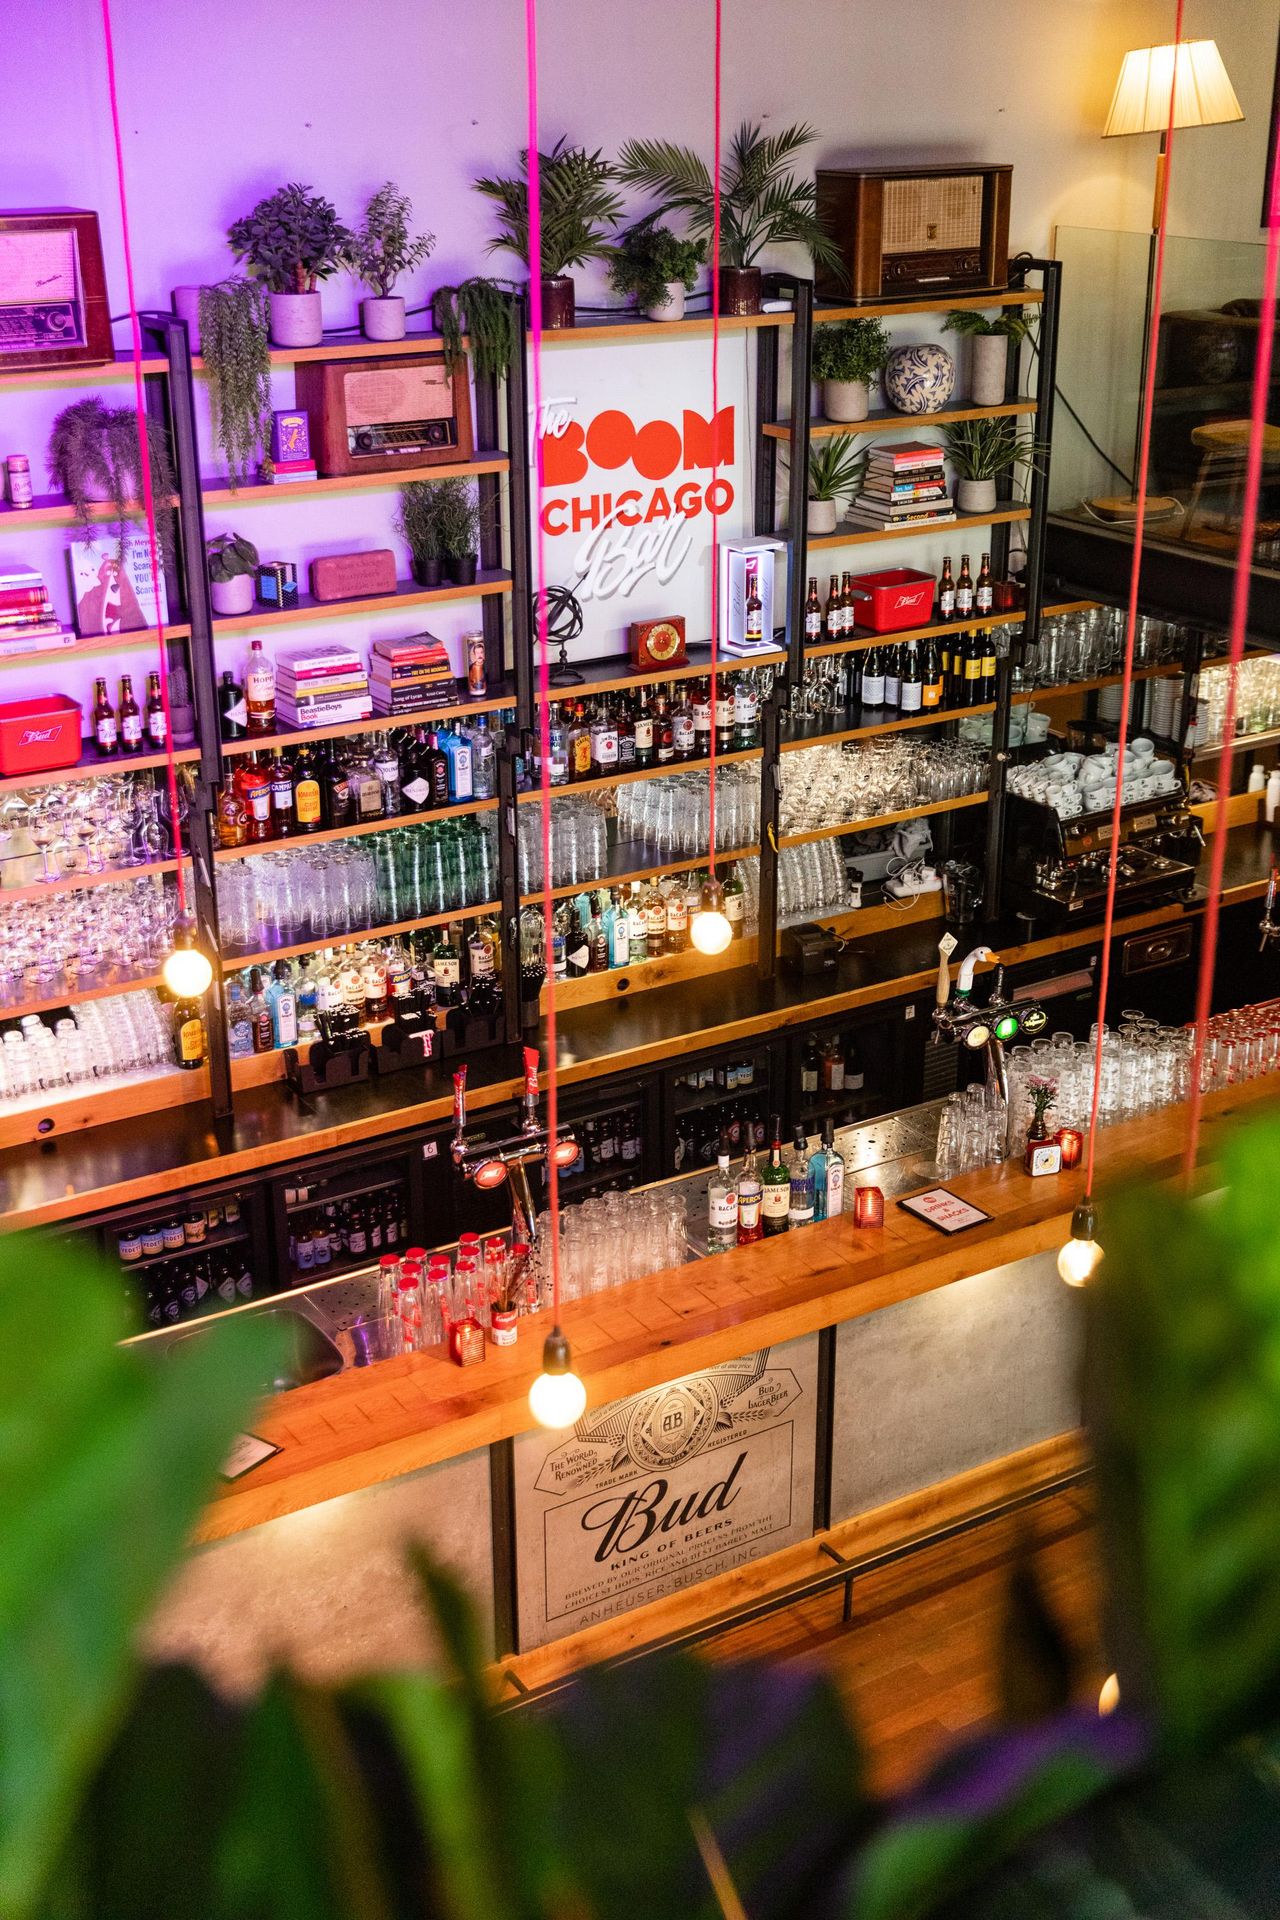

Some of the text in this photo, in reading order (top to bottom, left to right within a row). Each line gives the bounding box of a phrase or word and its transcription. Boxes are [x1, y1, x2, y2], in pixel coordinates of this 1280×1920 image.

[528, 396, 577, 467] The
[540, 405, 735, 488] BOOM
[541, 478, 735, 536] CHICAGO
[574, 500, 692, 602] Bar
[300, 713, 318, 721] Book
[427, 1145, 434, 1154] 6
[738, 1195, 762, 1204] APEROL
[764, 1186, 789, 1194] JAMESON
[924, 1200, 954, 1213] DRINKS
[937, 1208, 970, 1220] SNACKS
[662, 1411, 683, 1432] AB
[707, 1429, 748, 1448] REGISTERED
[550, 1462, 565, 1472] THE
[555, 1458, 598, 1481] RENOWNED
[595, 1470, 638, 1489] TRADE MARK
[581, 1451, 748, 1563] Bud
[610, 1518, 733, 1571] KING OF BEERS
[733, 1545, 761, 1563] INC.
[564, 1580, 605, 1601] BREWED
[621, 1566, 641, 1578] OUR
[688, 1532, 728, 1552] PROCESS
[564, 1587, 611, 1610] CHOICEST
[670, 1556, 688, 1568] AND
